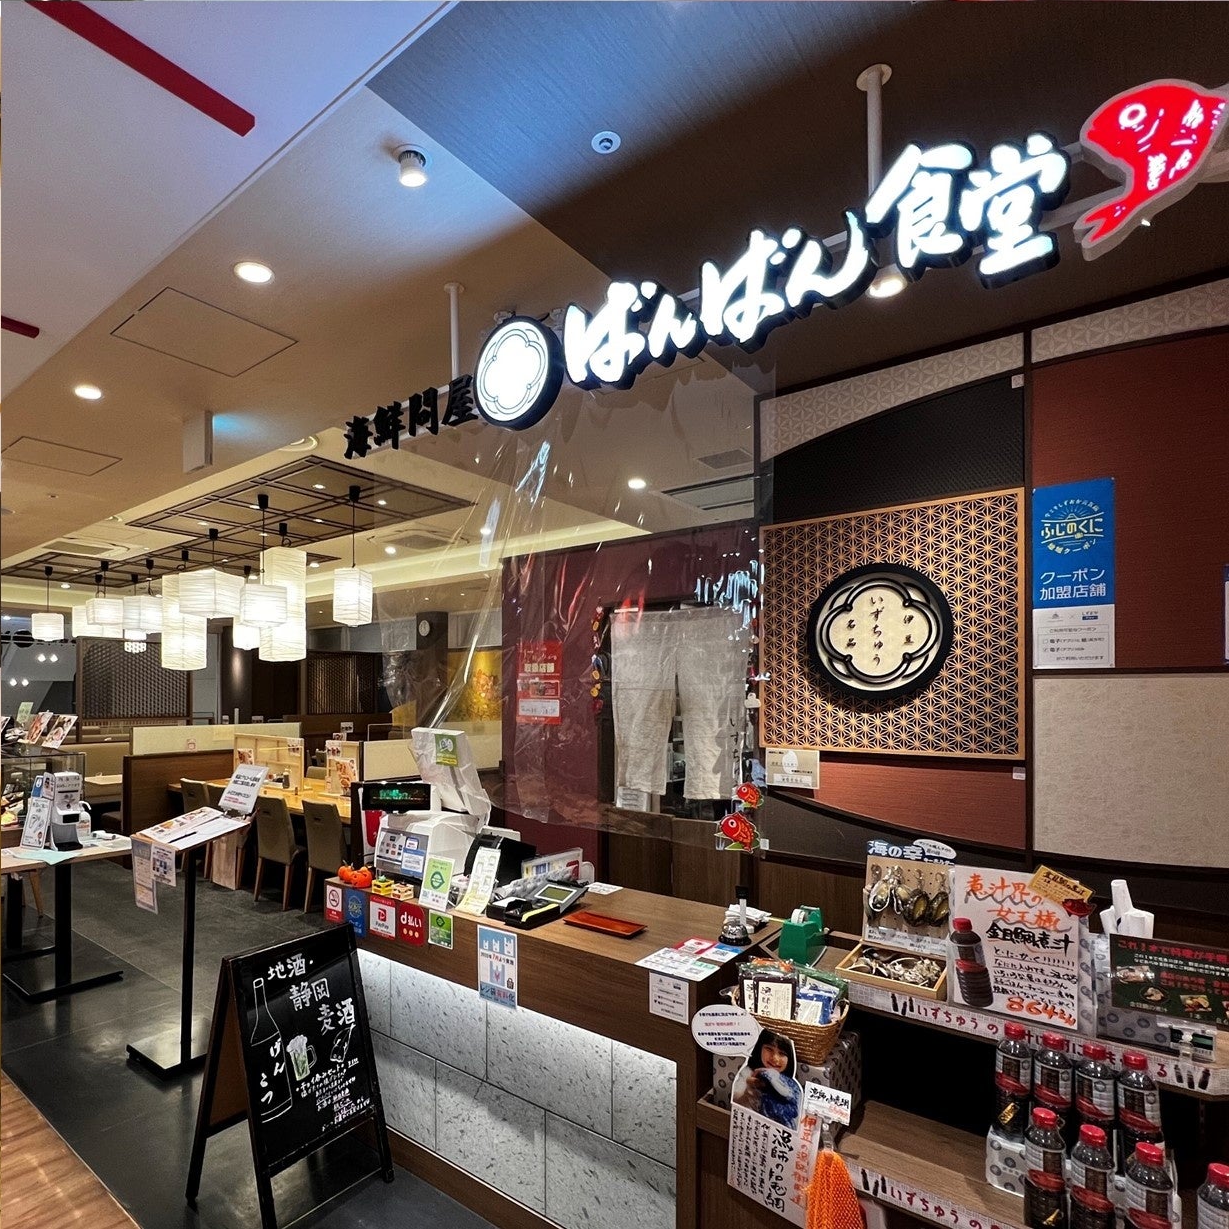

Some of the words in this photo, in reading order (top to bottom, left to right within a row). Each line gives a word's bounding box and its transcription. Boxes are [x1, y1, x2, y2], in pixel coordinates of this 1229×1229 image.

[343, 374, 479, 460] 海鮮問屋
[1041, 518, 1104, 540] ふじのくに
[1039, 583, 1107, 601] 加盟店舗
[1040, 568, 1106, 585] クーポン
[869, 596, 885, 666] いずちゅう
[867, 840, 923, 861] 海の幸
[289, 977, 331, 1012] 静岡
[317, 997, 357, 1036] 麦酒
[890, 1186, 1002, 1229] いずちゅうの
